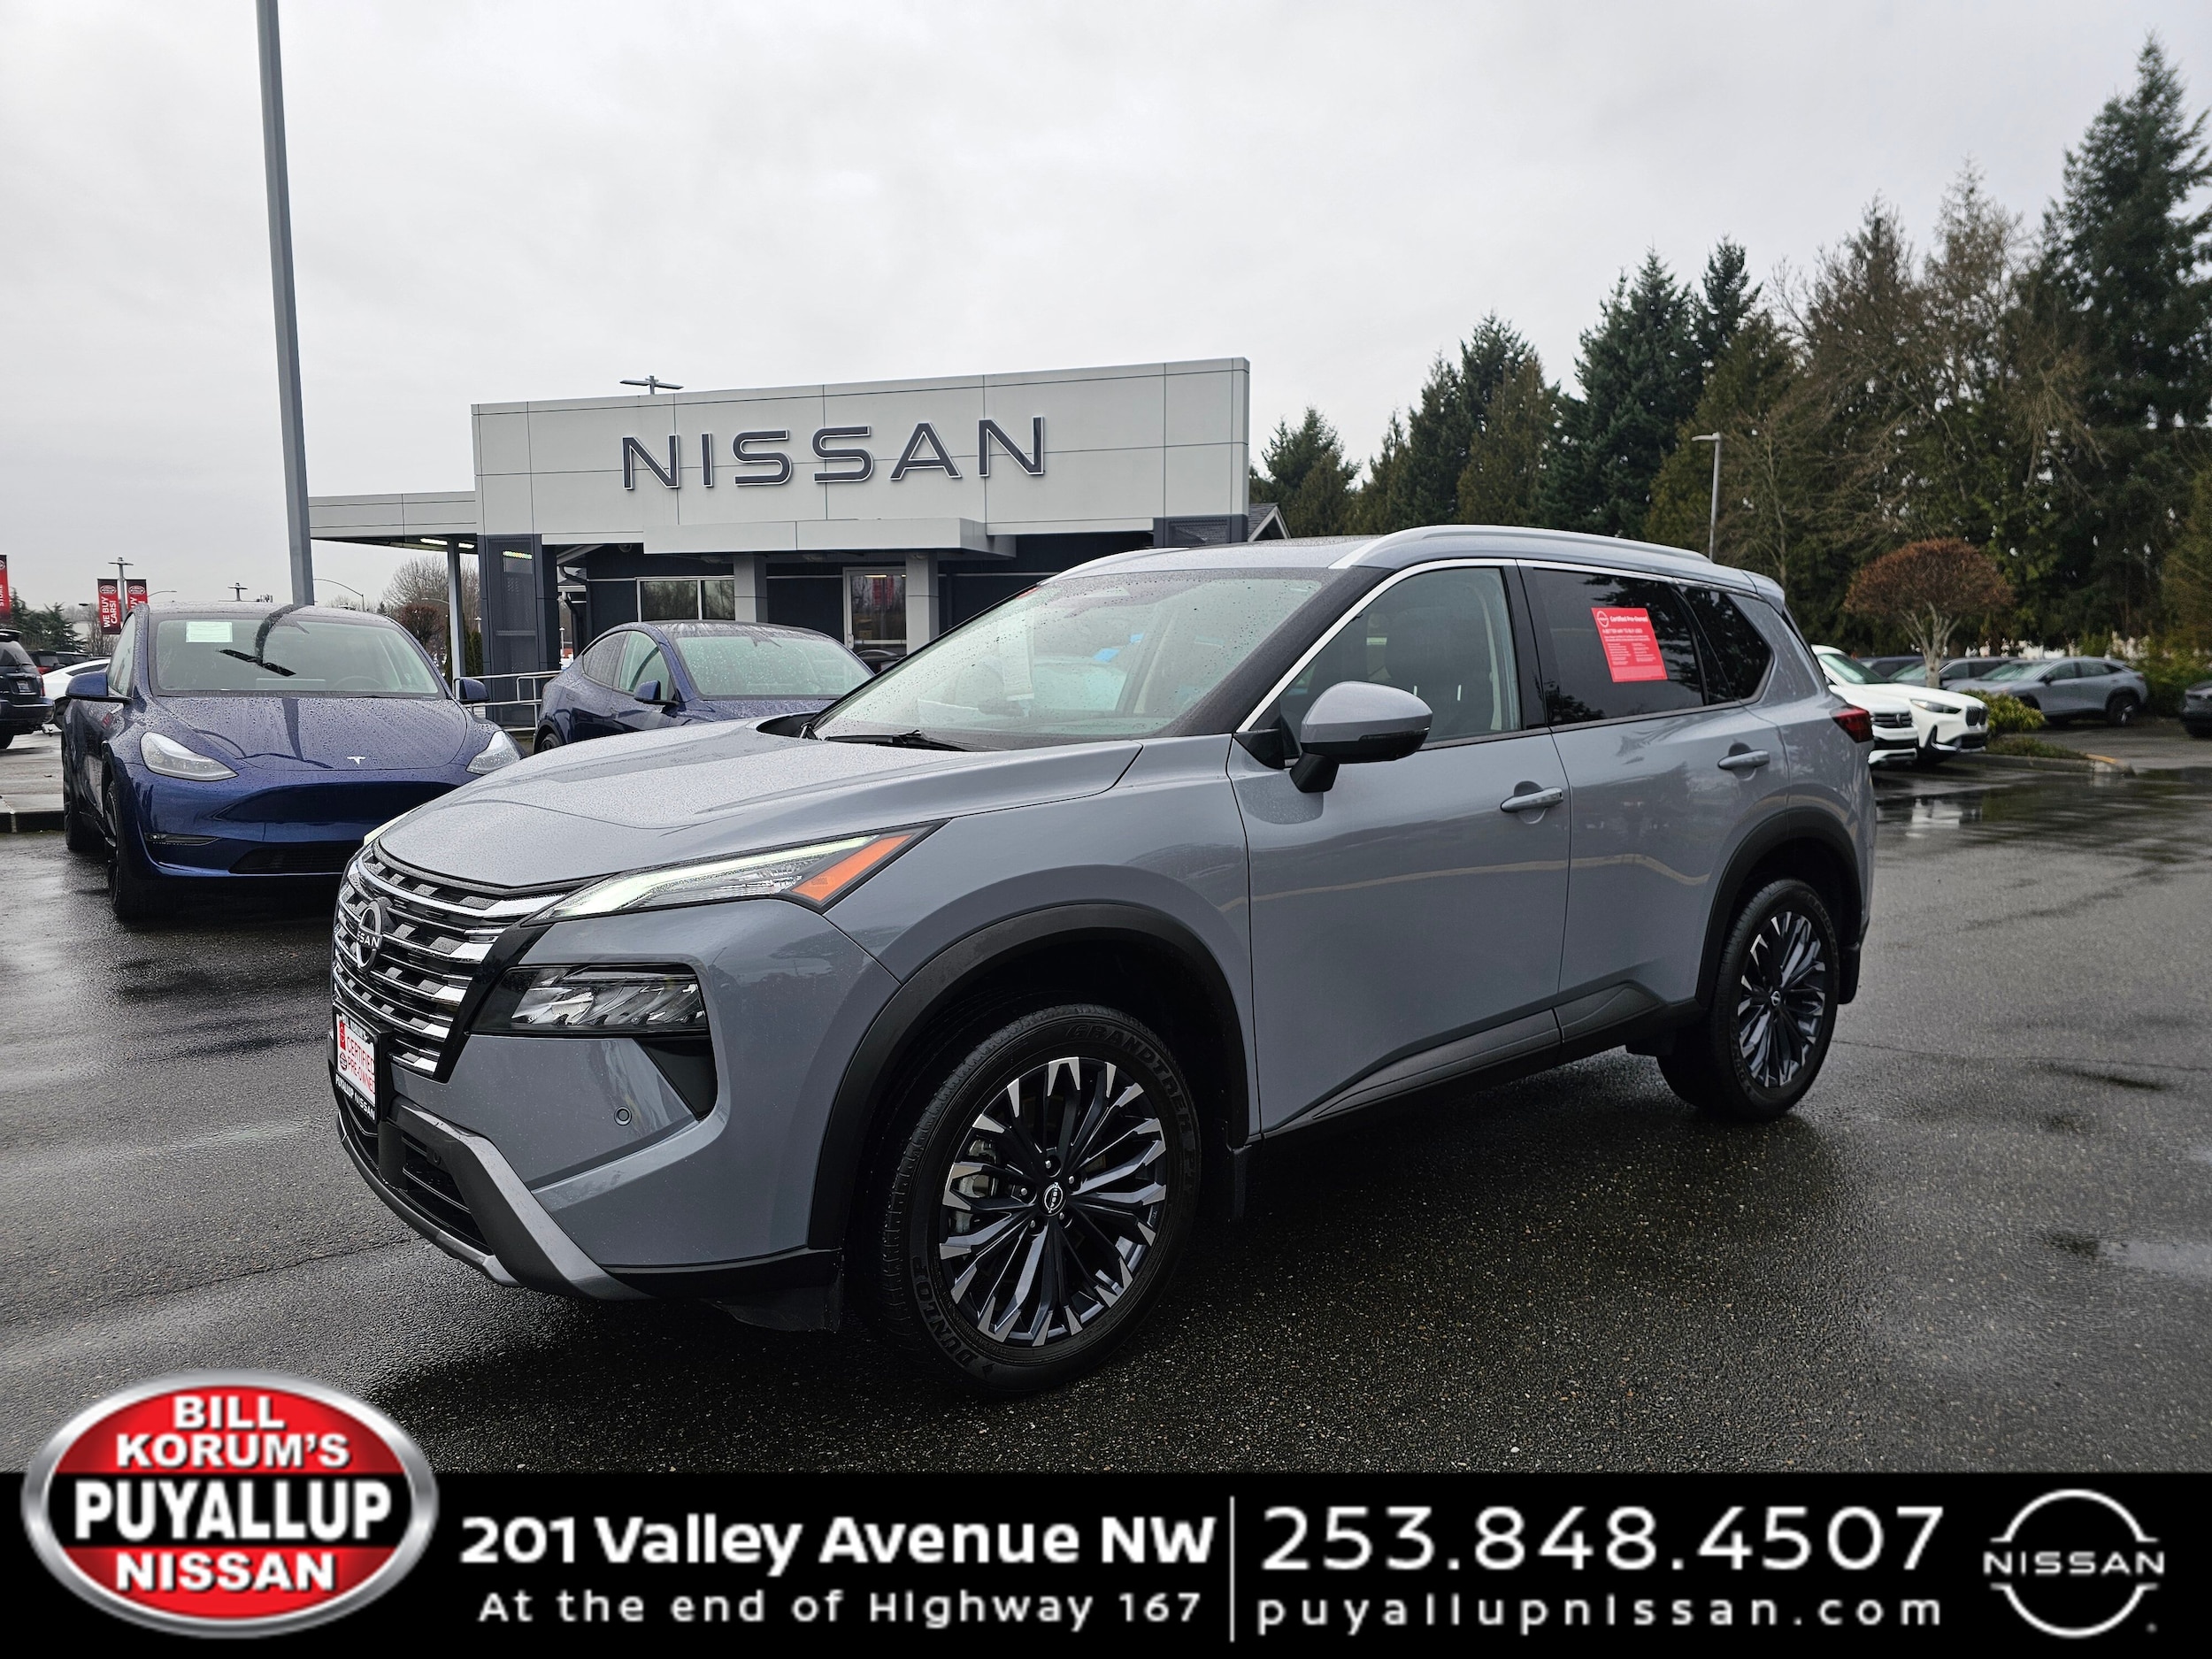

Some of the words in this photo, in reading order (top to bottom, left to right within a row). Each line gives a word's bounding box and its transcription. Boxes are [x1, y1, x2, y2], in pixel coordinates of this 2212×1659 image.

[622, 416, 1046, 490] NISSAN
[101, 596, 110, 613] BUY
[103, 614, 111, 628] WE
[354, 1092, 375, 1121] NISSAN
[912, 1256, 979, 1367] DUNLOP
